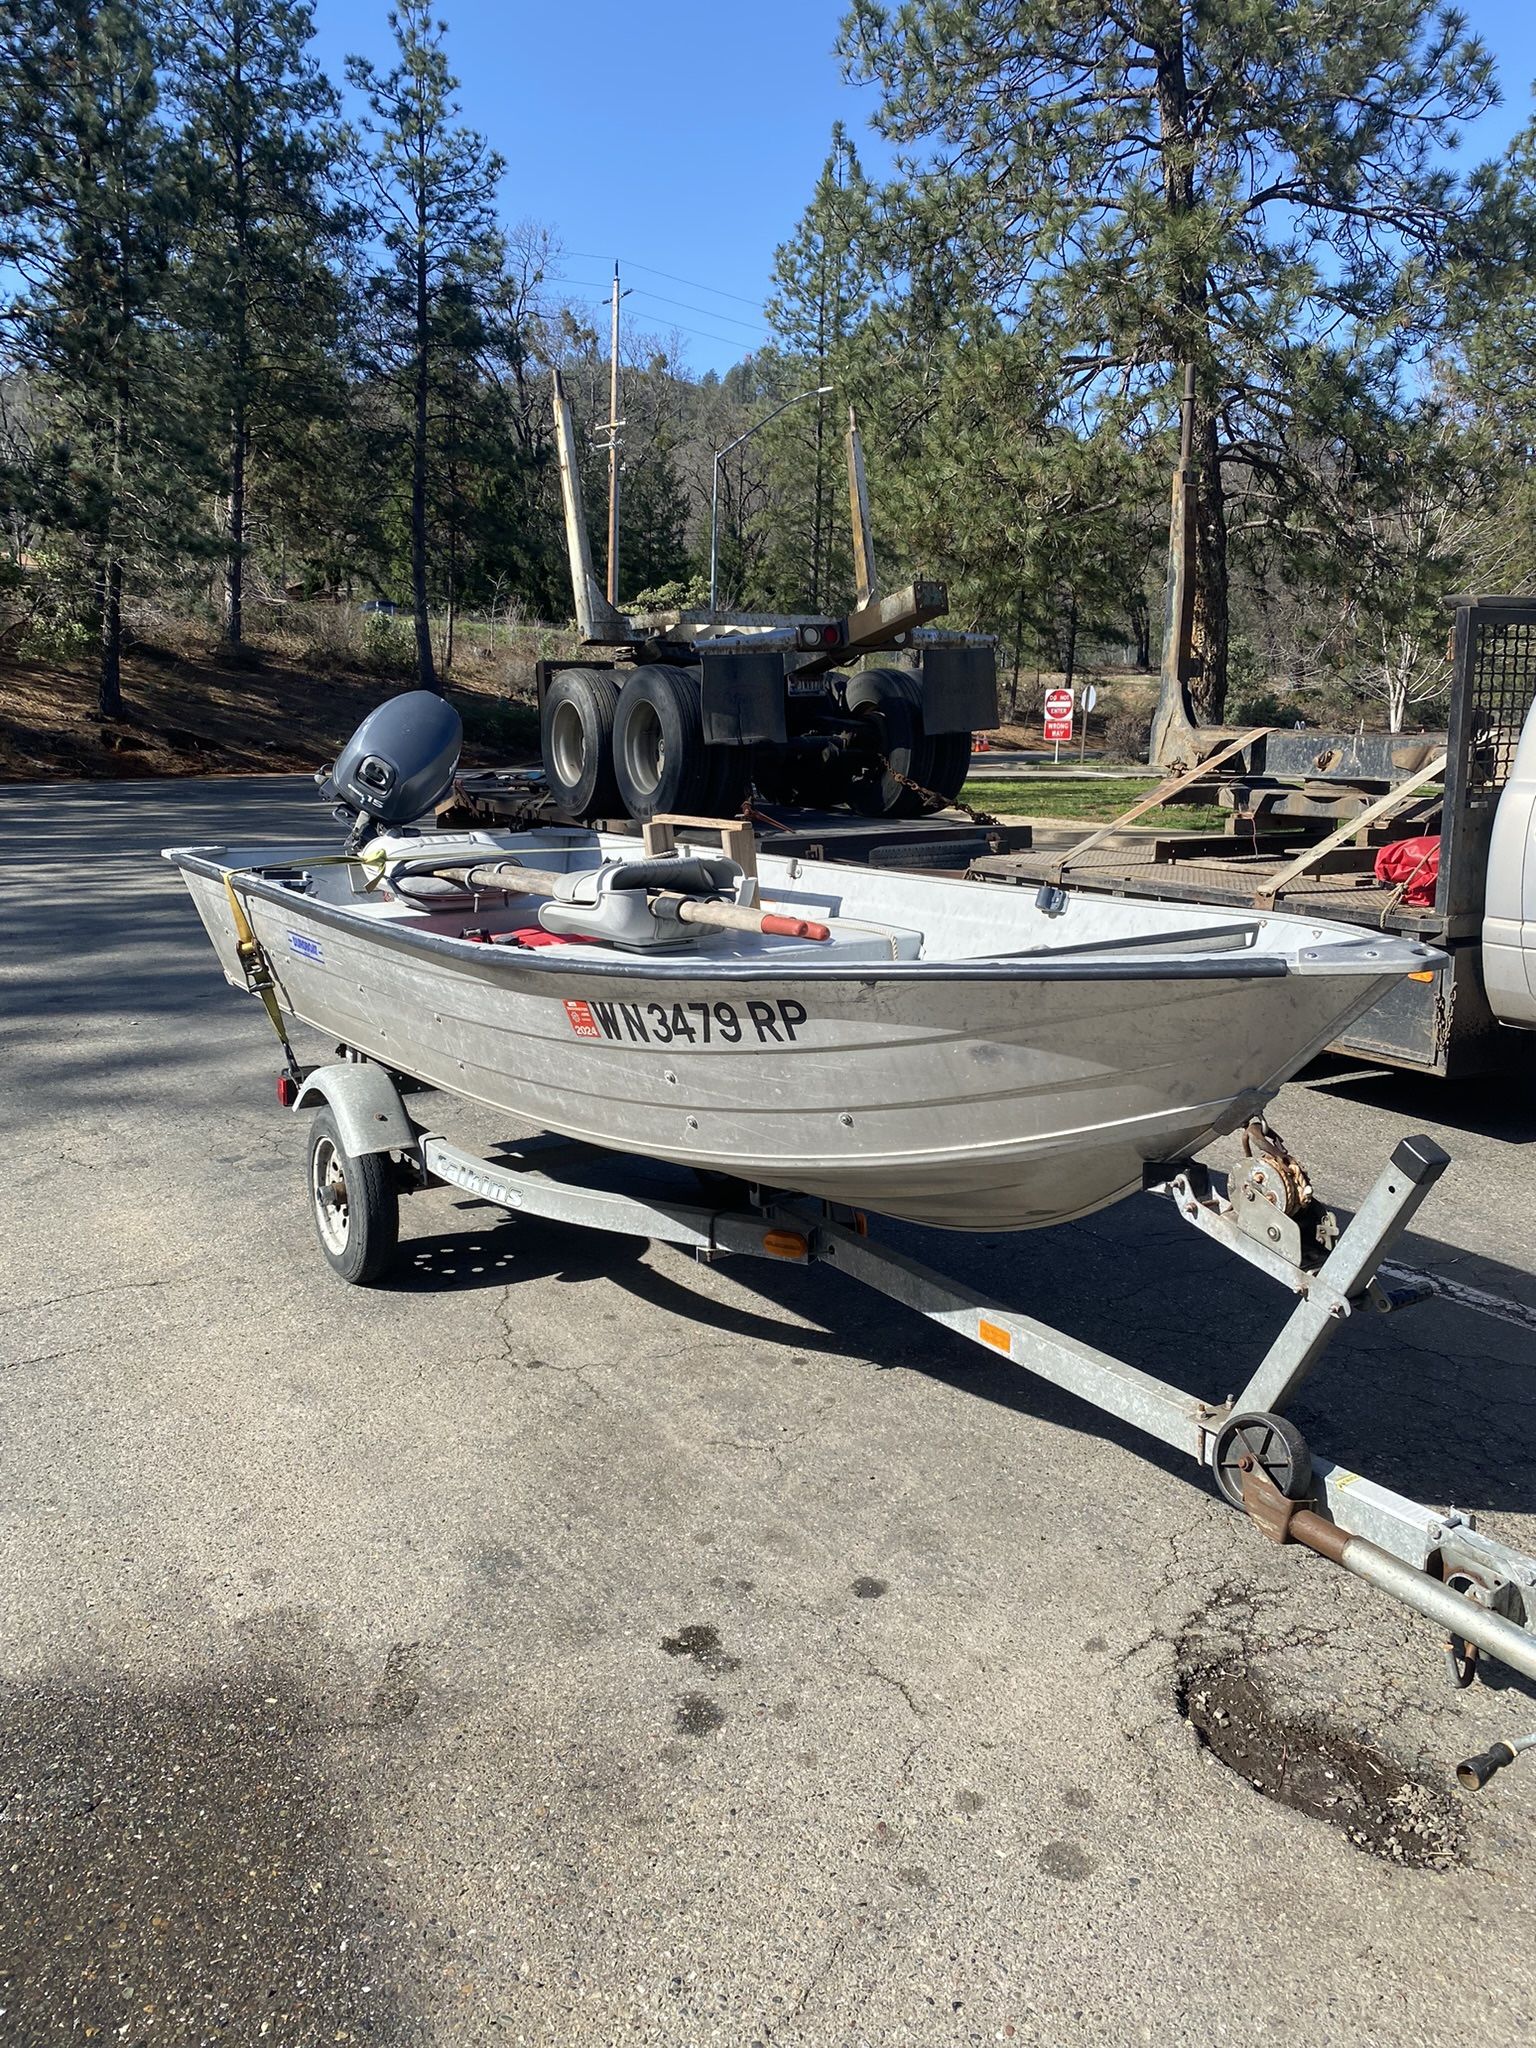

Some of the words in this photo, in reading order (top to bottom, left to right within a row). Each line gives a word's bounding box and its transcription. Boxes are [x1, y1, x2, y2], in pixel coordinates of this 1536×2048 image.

[367, 794, 384, 809] 15
[746, 999, 808, 1043] RP
[574, 1025, 599, 1036] 2024
